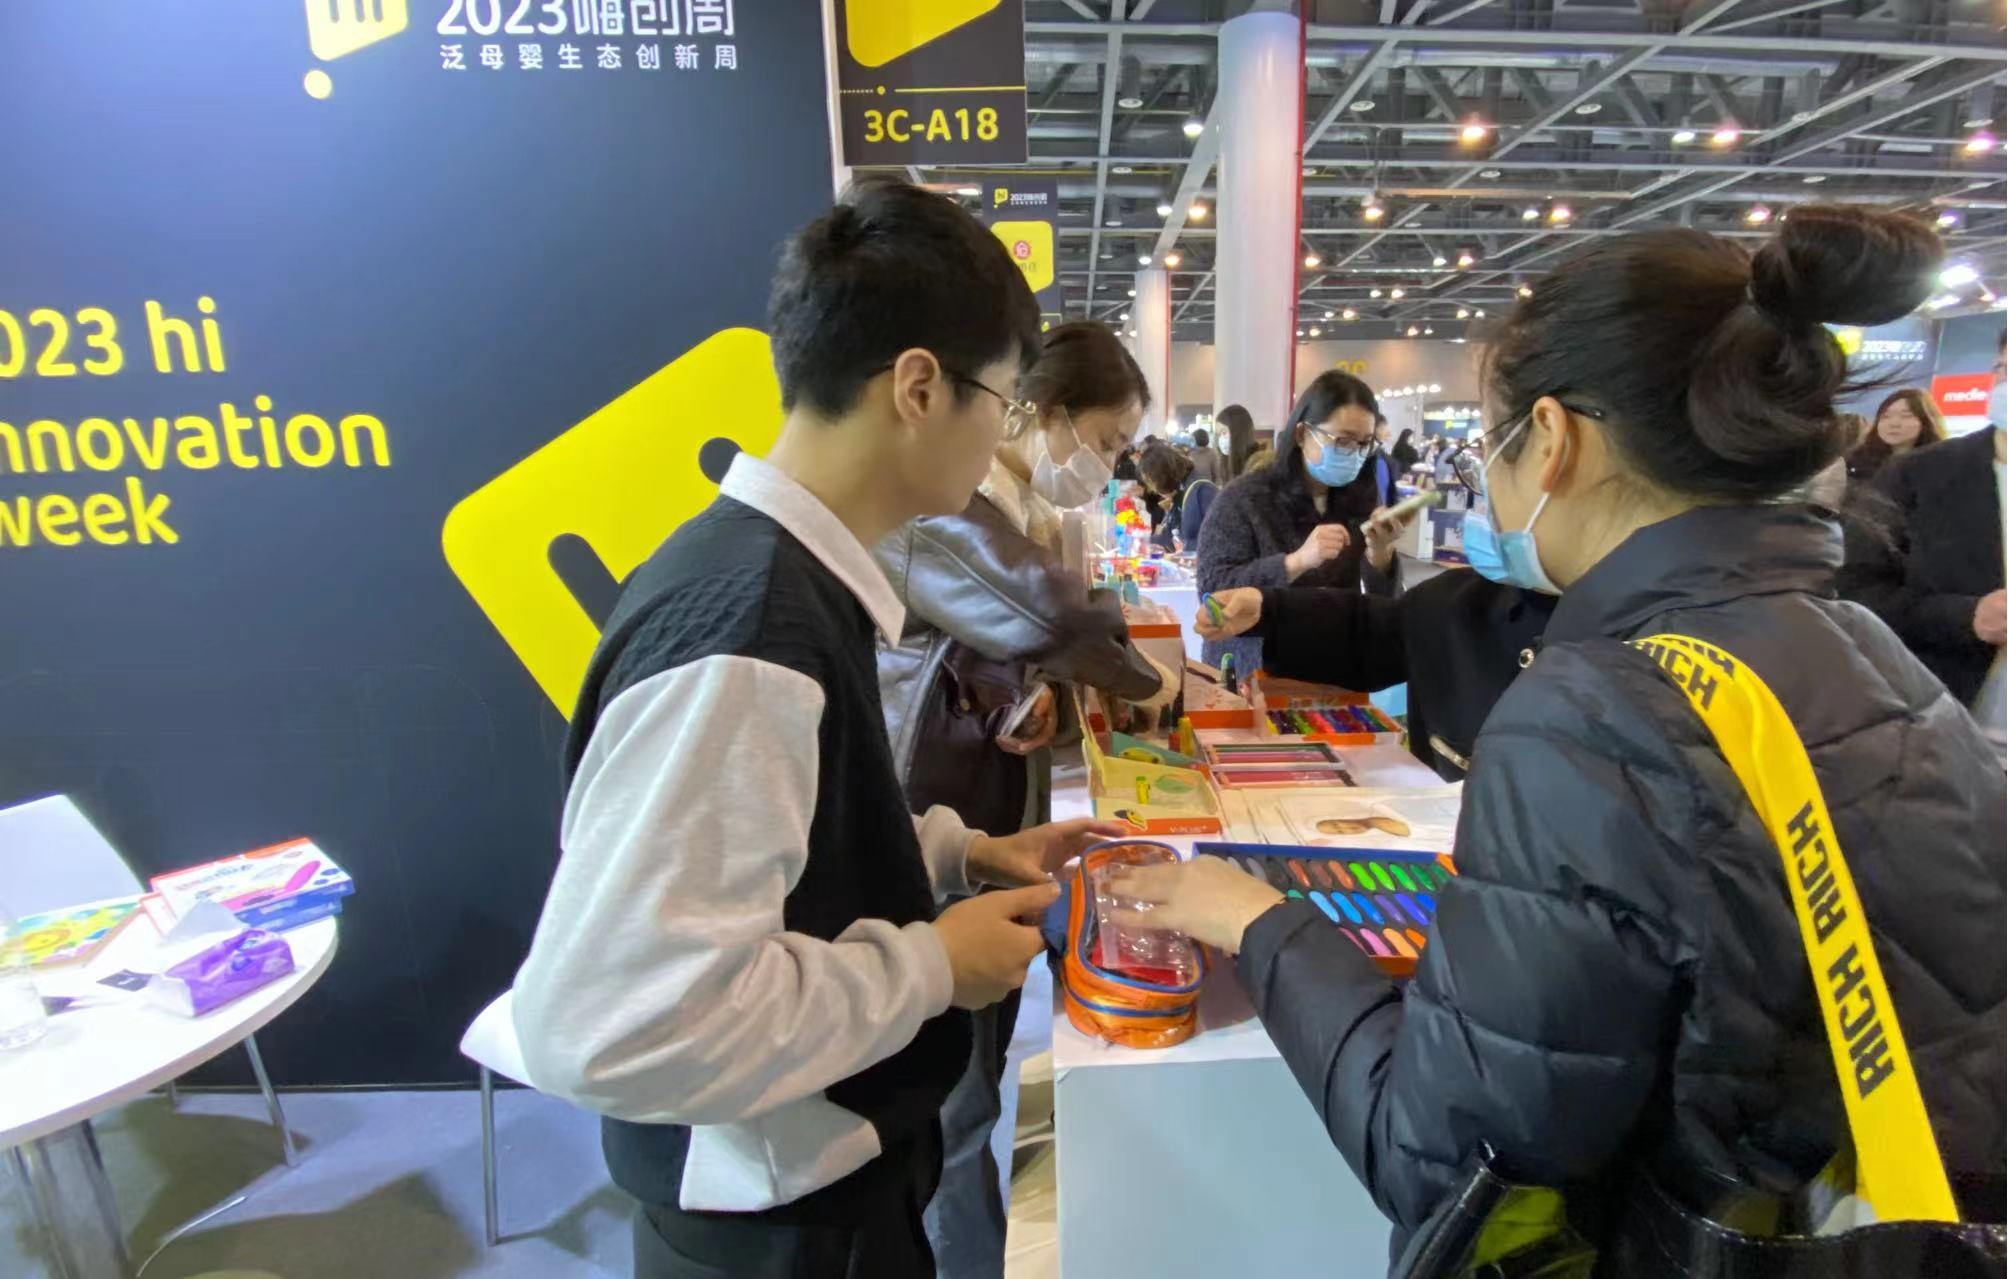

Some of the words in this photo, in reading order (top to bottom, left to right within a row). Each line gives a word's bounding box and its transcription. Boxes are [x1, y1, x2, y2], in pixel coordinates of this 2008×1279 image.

[439, 43, 738, 70] 泛母婴生态创新周
[864, 107, 998, 142] 3C-A18
[145, 296, 225, 373] hi
[1787, 800, 1847, 944] RICH
[1827, 942, 1895, 1100] RICH
